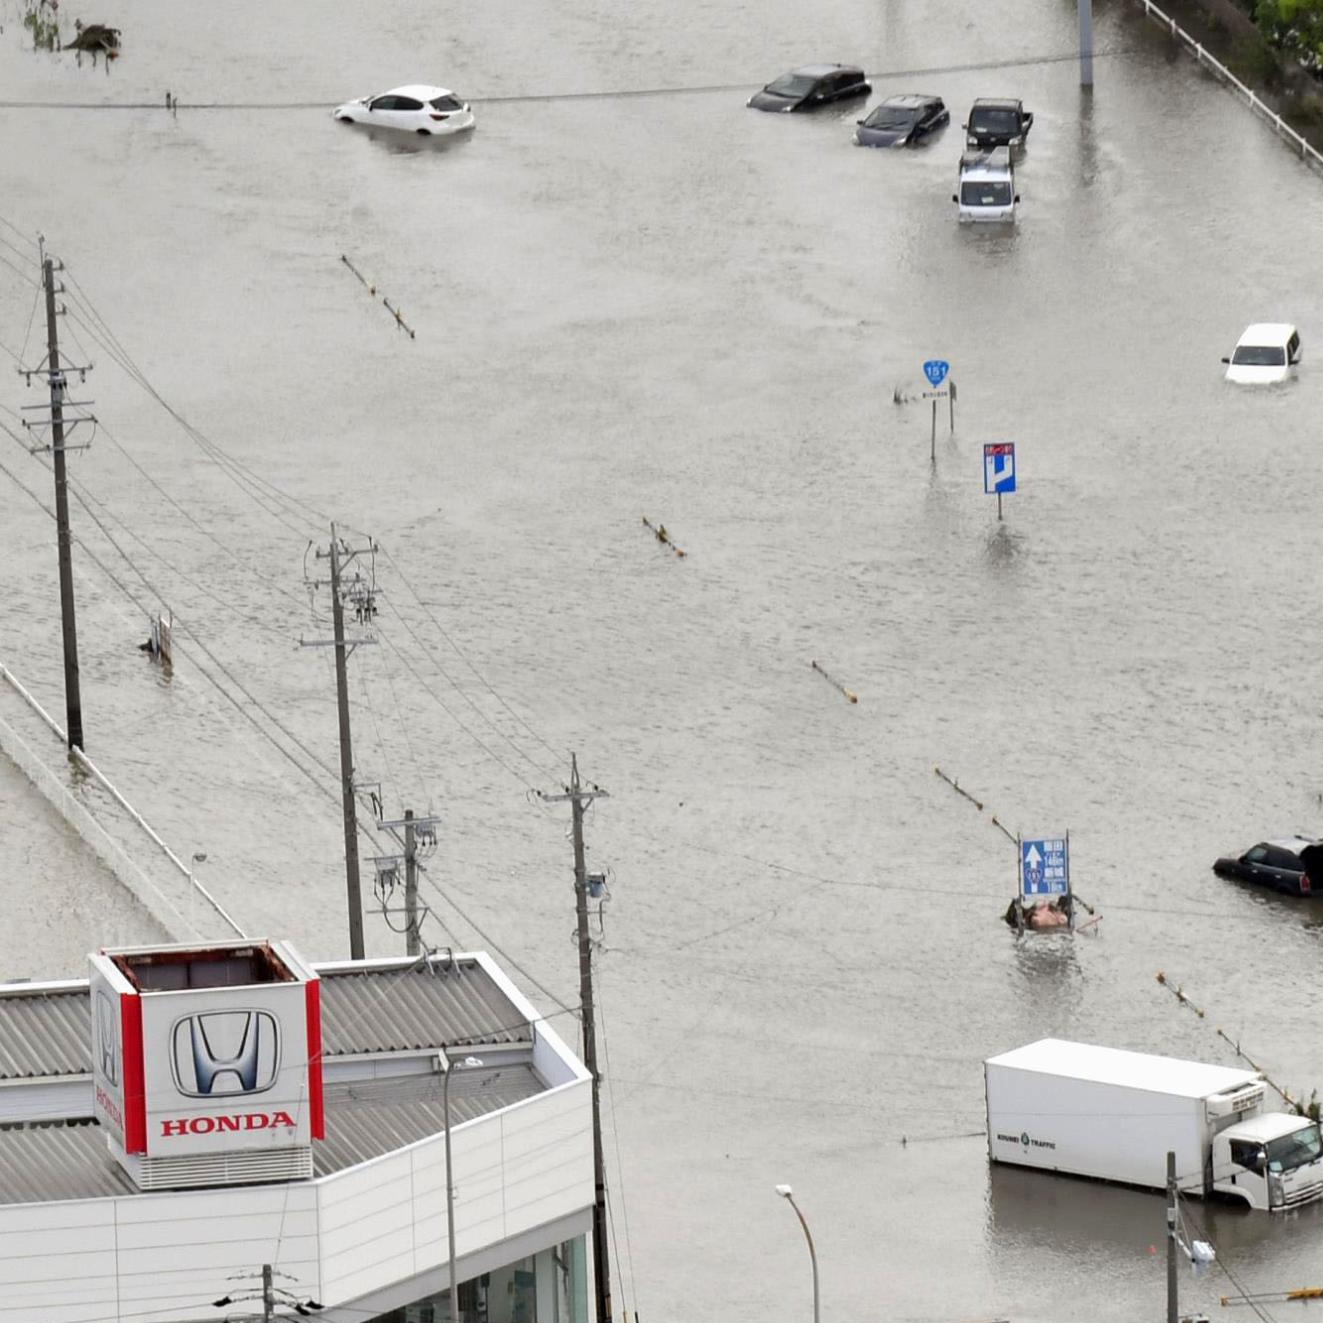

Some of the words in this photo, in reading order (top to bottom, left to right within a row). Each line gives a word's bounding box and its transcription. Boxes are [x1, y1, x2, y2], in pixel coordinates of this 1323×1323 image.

[927, 366, 946, 377] 151
[96, 1086, 124, 1132] HONDA
[161, 1111, 298, 1137] HONDA
[1031, 1139, 1056, 1150] TRAFFIC
